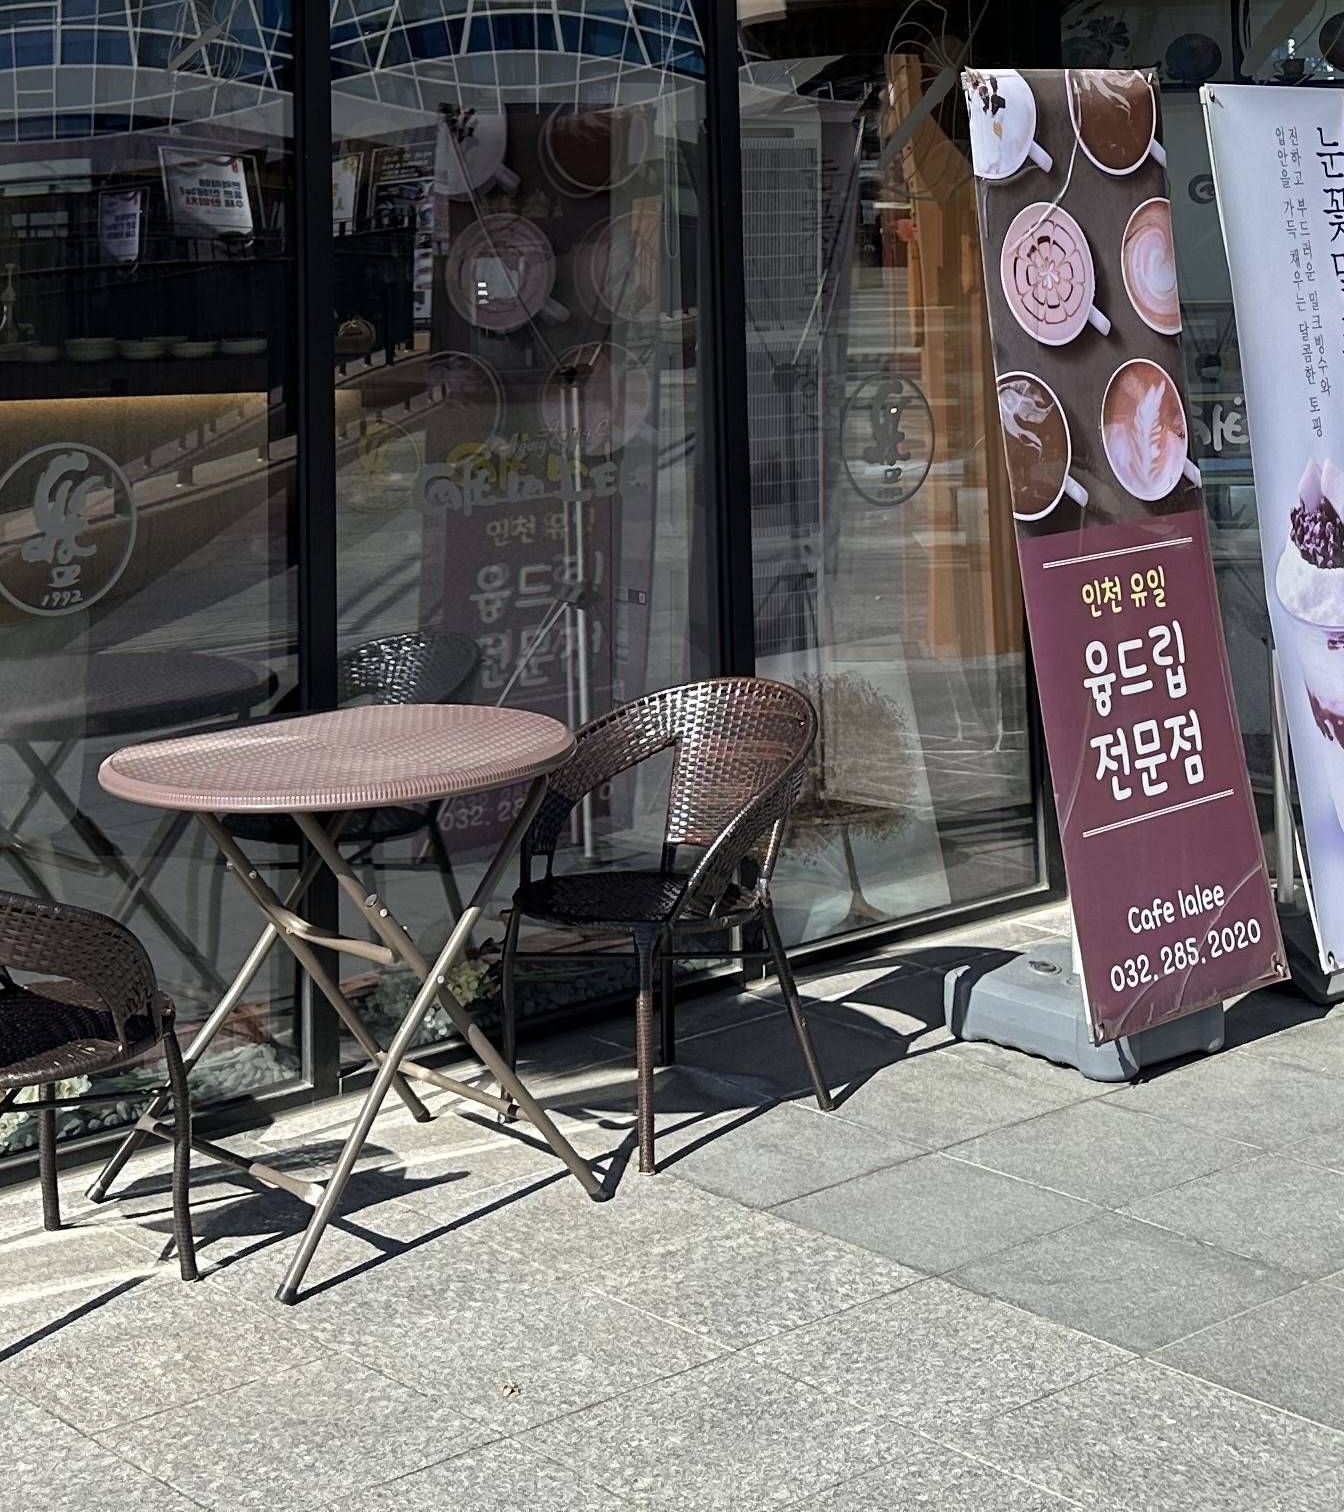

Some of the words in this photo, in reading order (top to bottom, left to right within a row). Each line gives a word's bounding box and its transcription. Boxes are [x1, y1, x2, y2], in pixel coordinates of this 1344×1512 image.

[1274, 126, 1292, 188] 입안을
[1282, 198, 1298, 239] 가득
[1287, 126, 1305, 187] 진하고
[1296, 198, 1316, 283] 부드러운
[1289, 250, 1307, 313] 채우는
[1297, 320, 1316, 386] 달콤한
[1309, 395, 1324, 439] 토핑
[41, 589, 84, 607] 1992
[1081, 575, 1123, 618] 인천
[1130, 565, 1167, 608] 유일
[1083, 619, 1188, 717] 융드립
[1089, 708, 1205, 801] 전문점
[1127, 898, 1176, 935] Cafe
[1177, 884, 1226, 919] lalee
